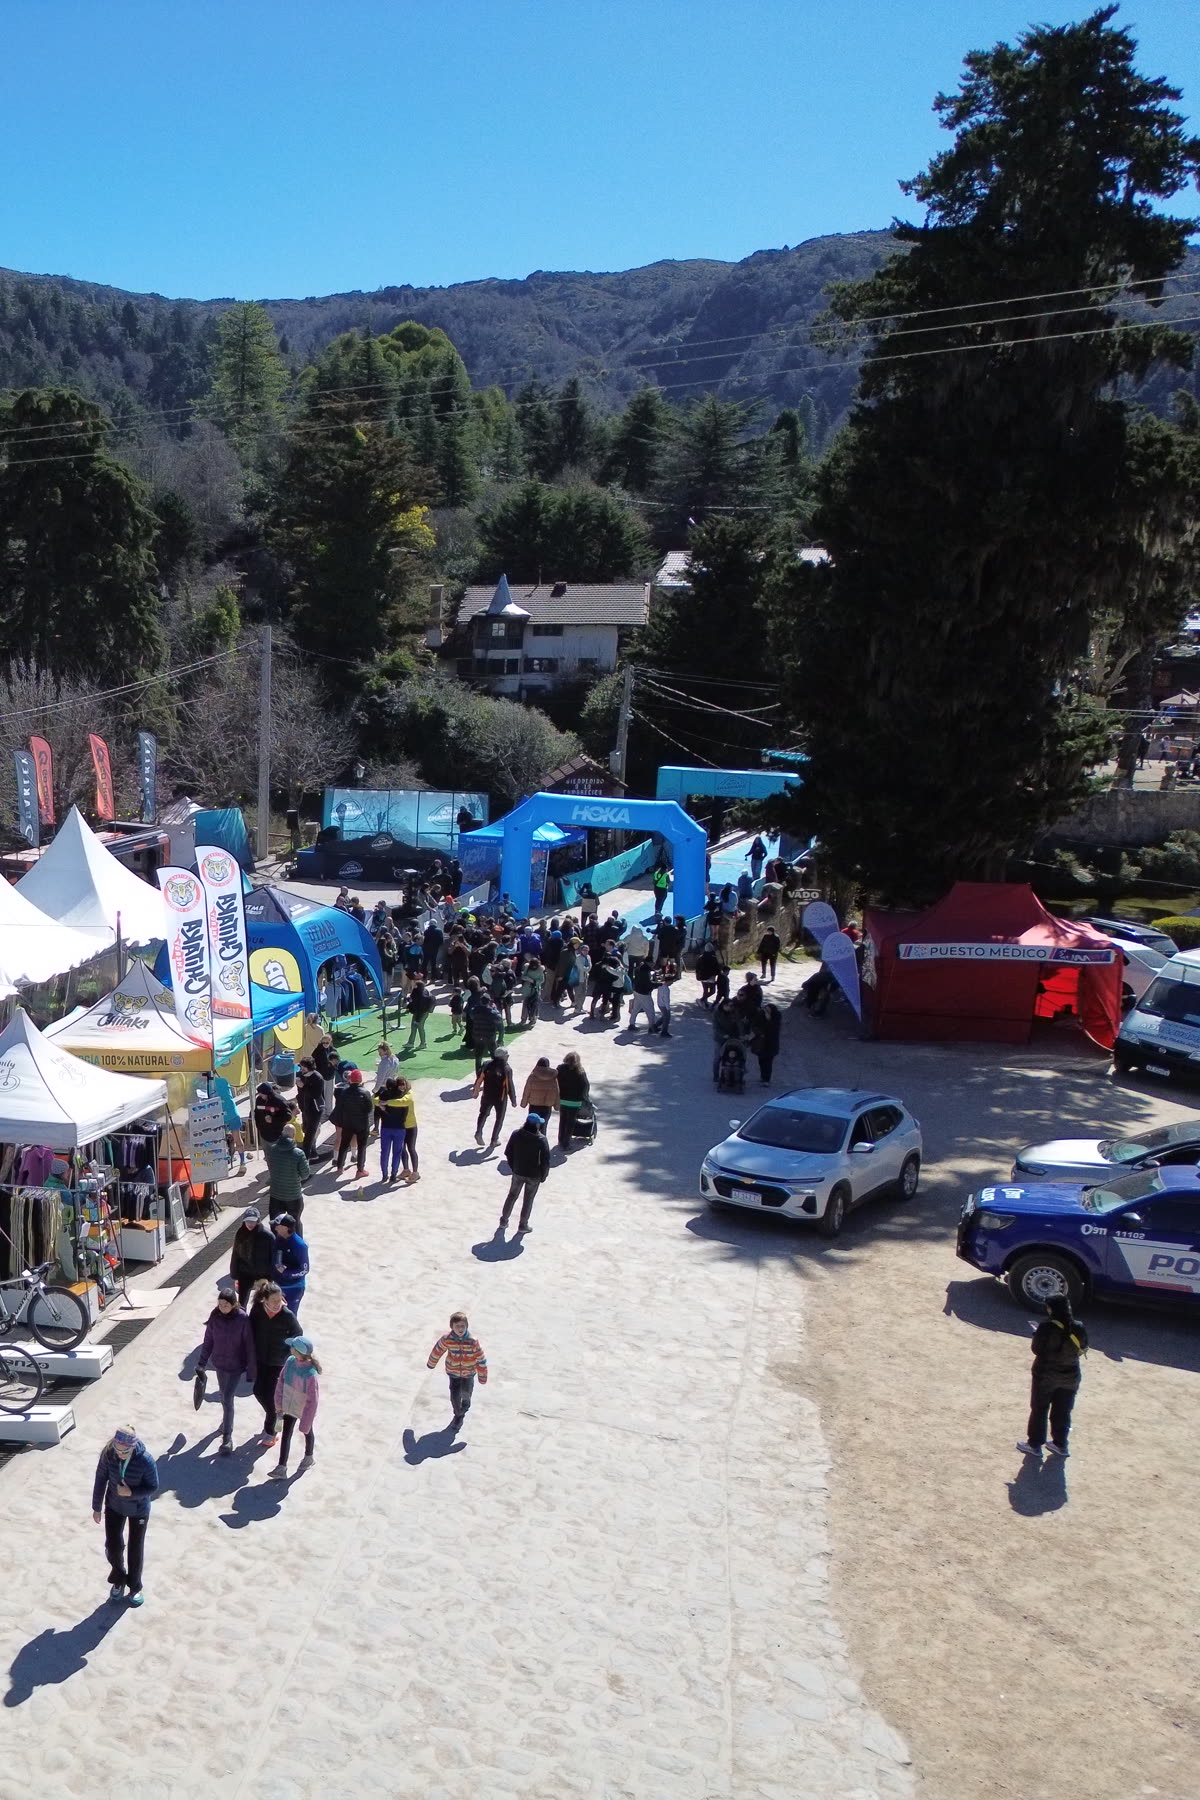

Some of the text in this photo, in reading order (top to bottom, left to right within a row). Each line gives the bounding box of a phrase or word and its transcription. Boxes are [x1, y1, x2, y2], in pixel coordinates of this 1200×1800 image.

[571, 805, 630, 824] HOKA
[788, 891, 820, 899] VADO
[930, 944, 1047, 958] PUESTO MÉDICO
[96, 1012, 150, 1029] CHITAKA
[102, 1055, 127, 1066] 100%
[127, 1055, 170, 1067] NATURAL
[1092, 1226, 1107, 1235] 911
[1115, 1230, 1146, 1239] 11102
